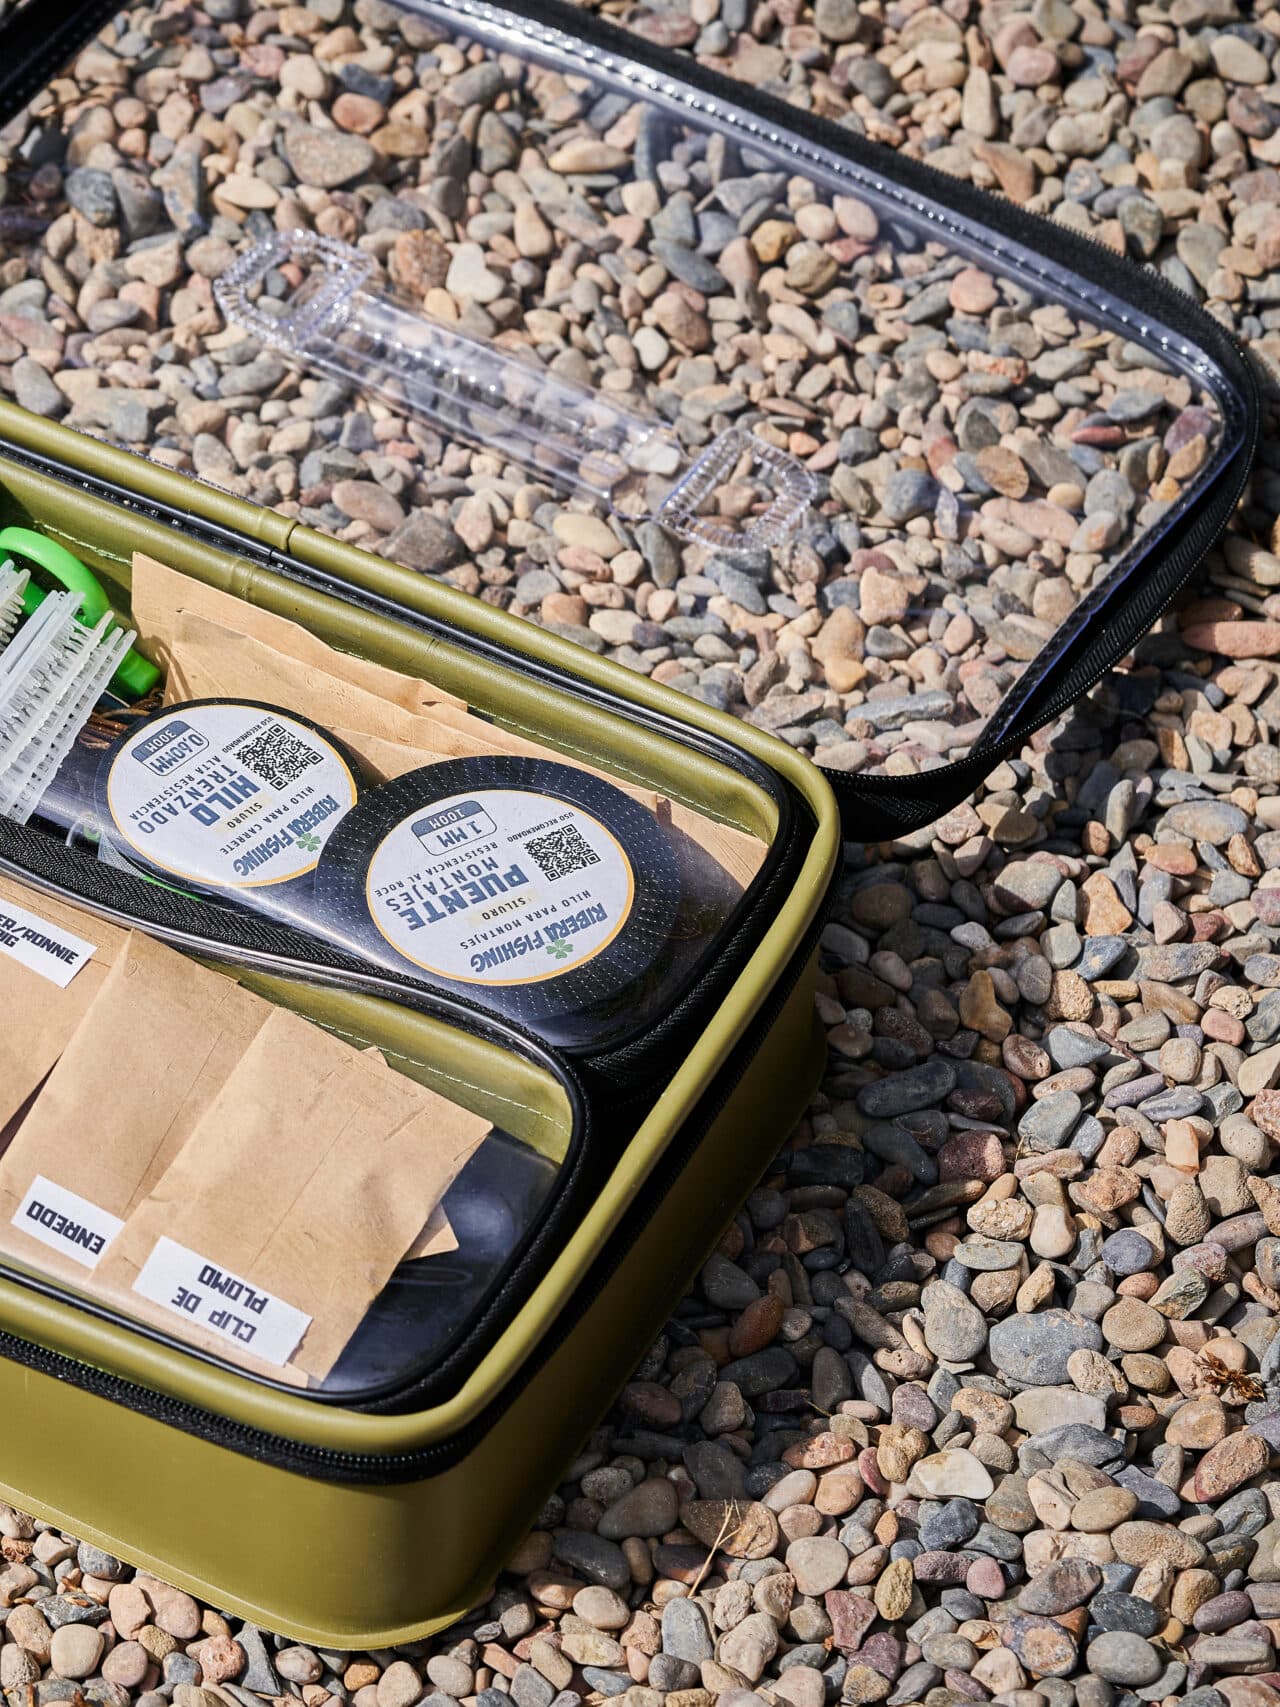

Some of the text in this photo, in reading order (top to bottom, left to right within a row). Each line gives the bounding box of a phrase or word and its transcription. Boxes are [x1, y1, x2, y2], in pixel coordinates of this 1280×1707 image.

[144, 730, 176, 752] 300M
[150, 733, 204, 773] 0,60MM
[222, 716, 274, 753] USO RECOMENDADO
[129, 756, 220, 820] ALTA RESISTENCIA
[138, 764, 238, 834] TRENZADO
[190, 774, 261, 826] HILO
[227, 802, 263, 828] SILURO
[220, 786, 315, 855] HILO PARA CARRETE
[232, 794, 341, 876] RIBERA FISHING
[429, 808, 465, 830] 100M
[436, 820, 482, 848] 1 MM
[507, 812, 575, 842] USO RECOMENDADO
[374, 842, 498, 898] RESISTENCIA AL ROCE
[386, 856, 500, 912] MONTAJES
[398, 863, 530, 931] PUENTE
[460, 890, 592, 950] HILO PARA MONTAJES
[482, 897, 526, 920] SILURO
[470, 902, 608, 972] RIBERA FISHING
[26, 1200, 106, 1255] ENREDO
[171, 1286, 257, 1344] CLIP DE
[198, 1264, 269, 1315] PLOMO
